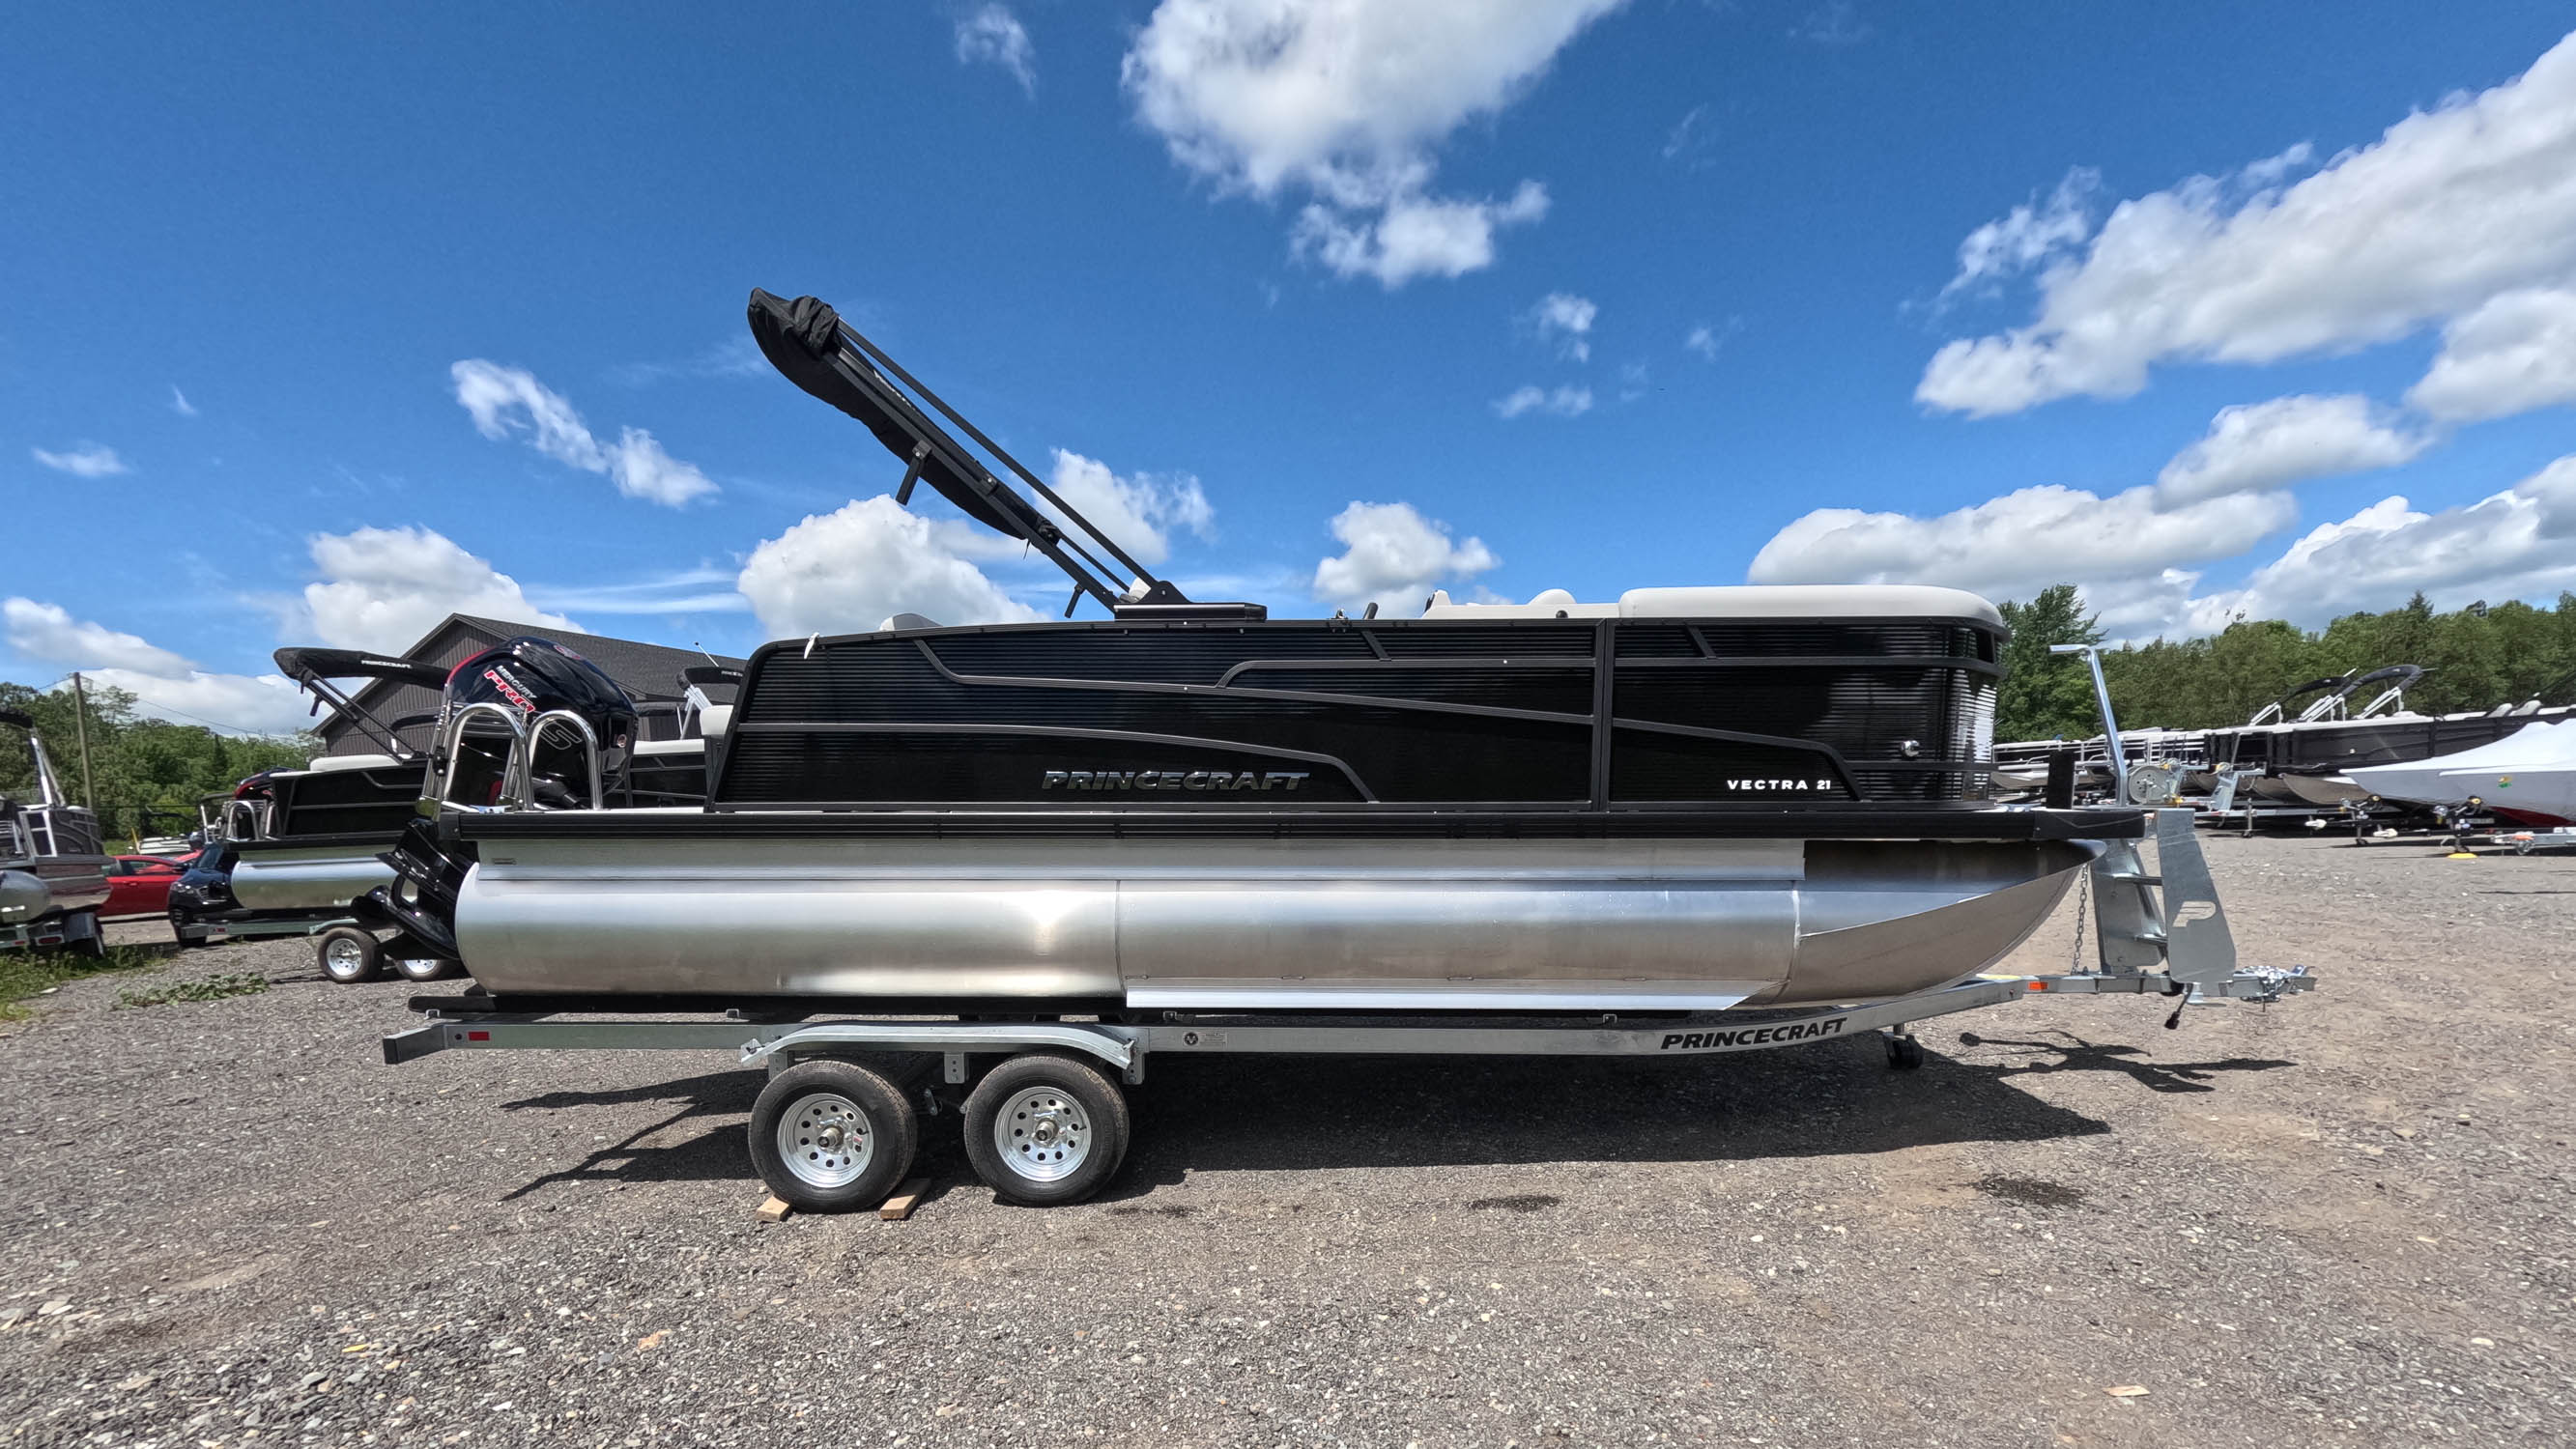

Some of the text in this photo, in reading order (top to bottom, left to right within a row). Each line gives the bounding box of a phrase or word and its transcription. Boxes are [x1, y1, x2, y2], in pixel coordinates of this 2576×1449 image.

[483, 669, 535, 714] PRO
[496, 665, 537, 698] MERCURY
[1042, 770, 1310, 790] PRINCECRAFT
[1727, 780, 1831, 790] VECTRA 21
[1660, 1017, 1847, 1050] PRINCECRAFT
